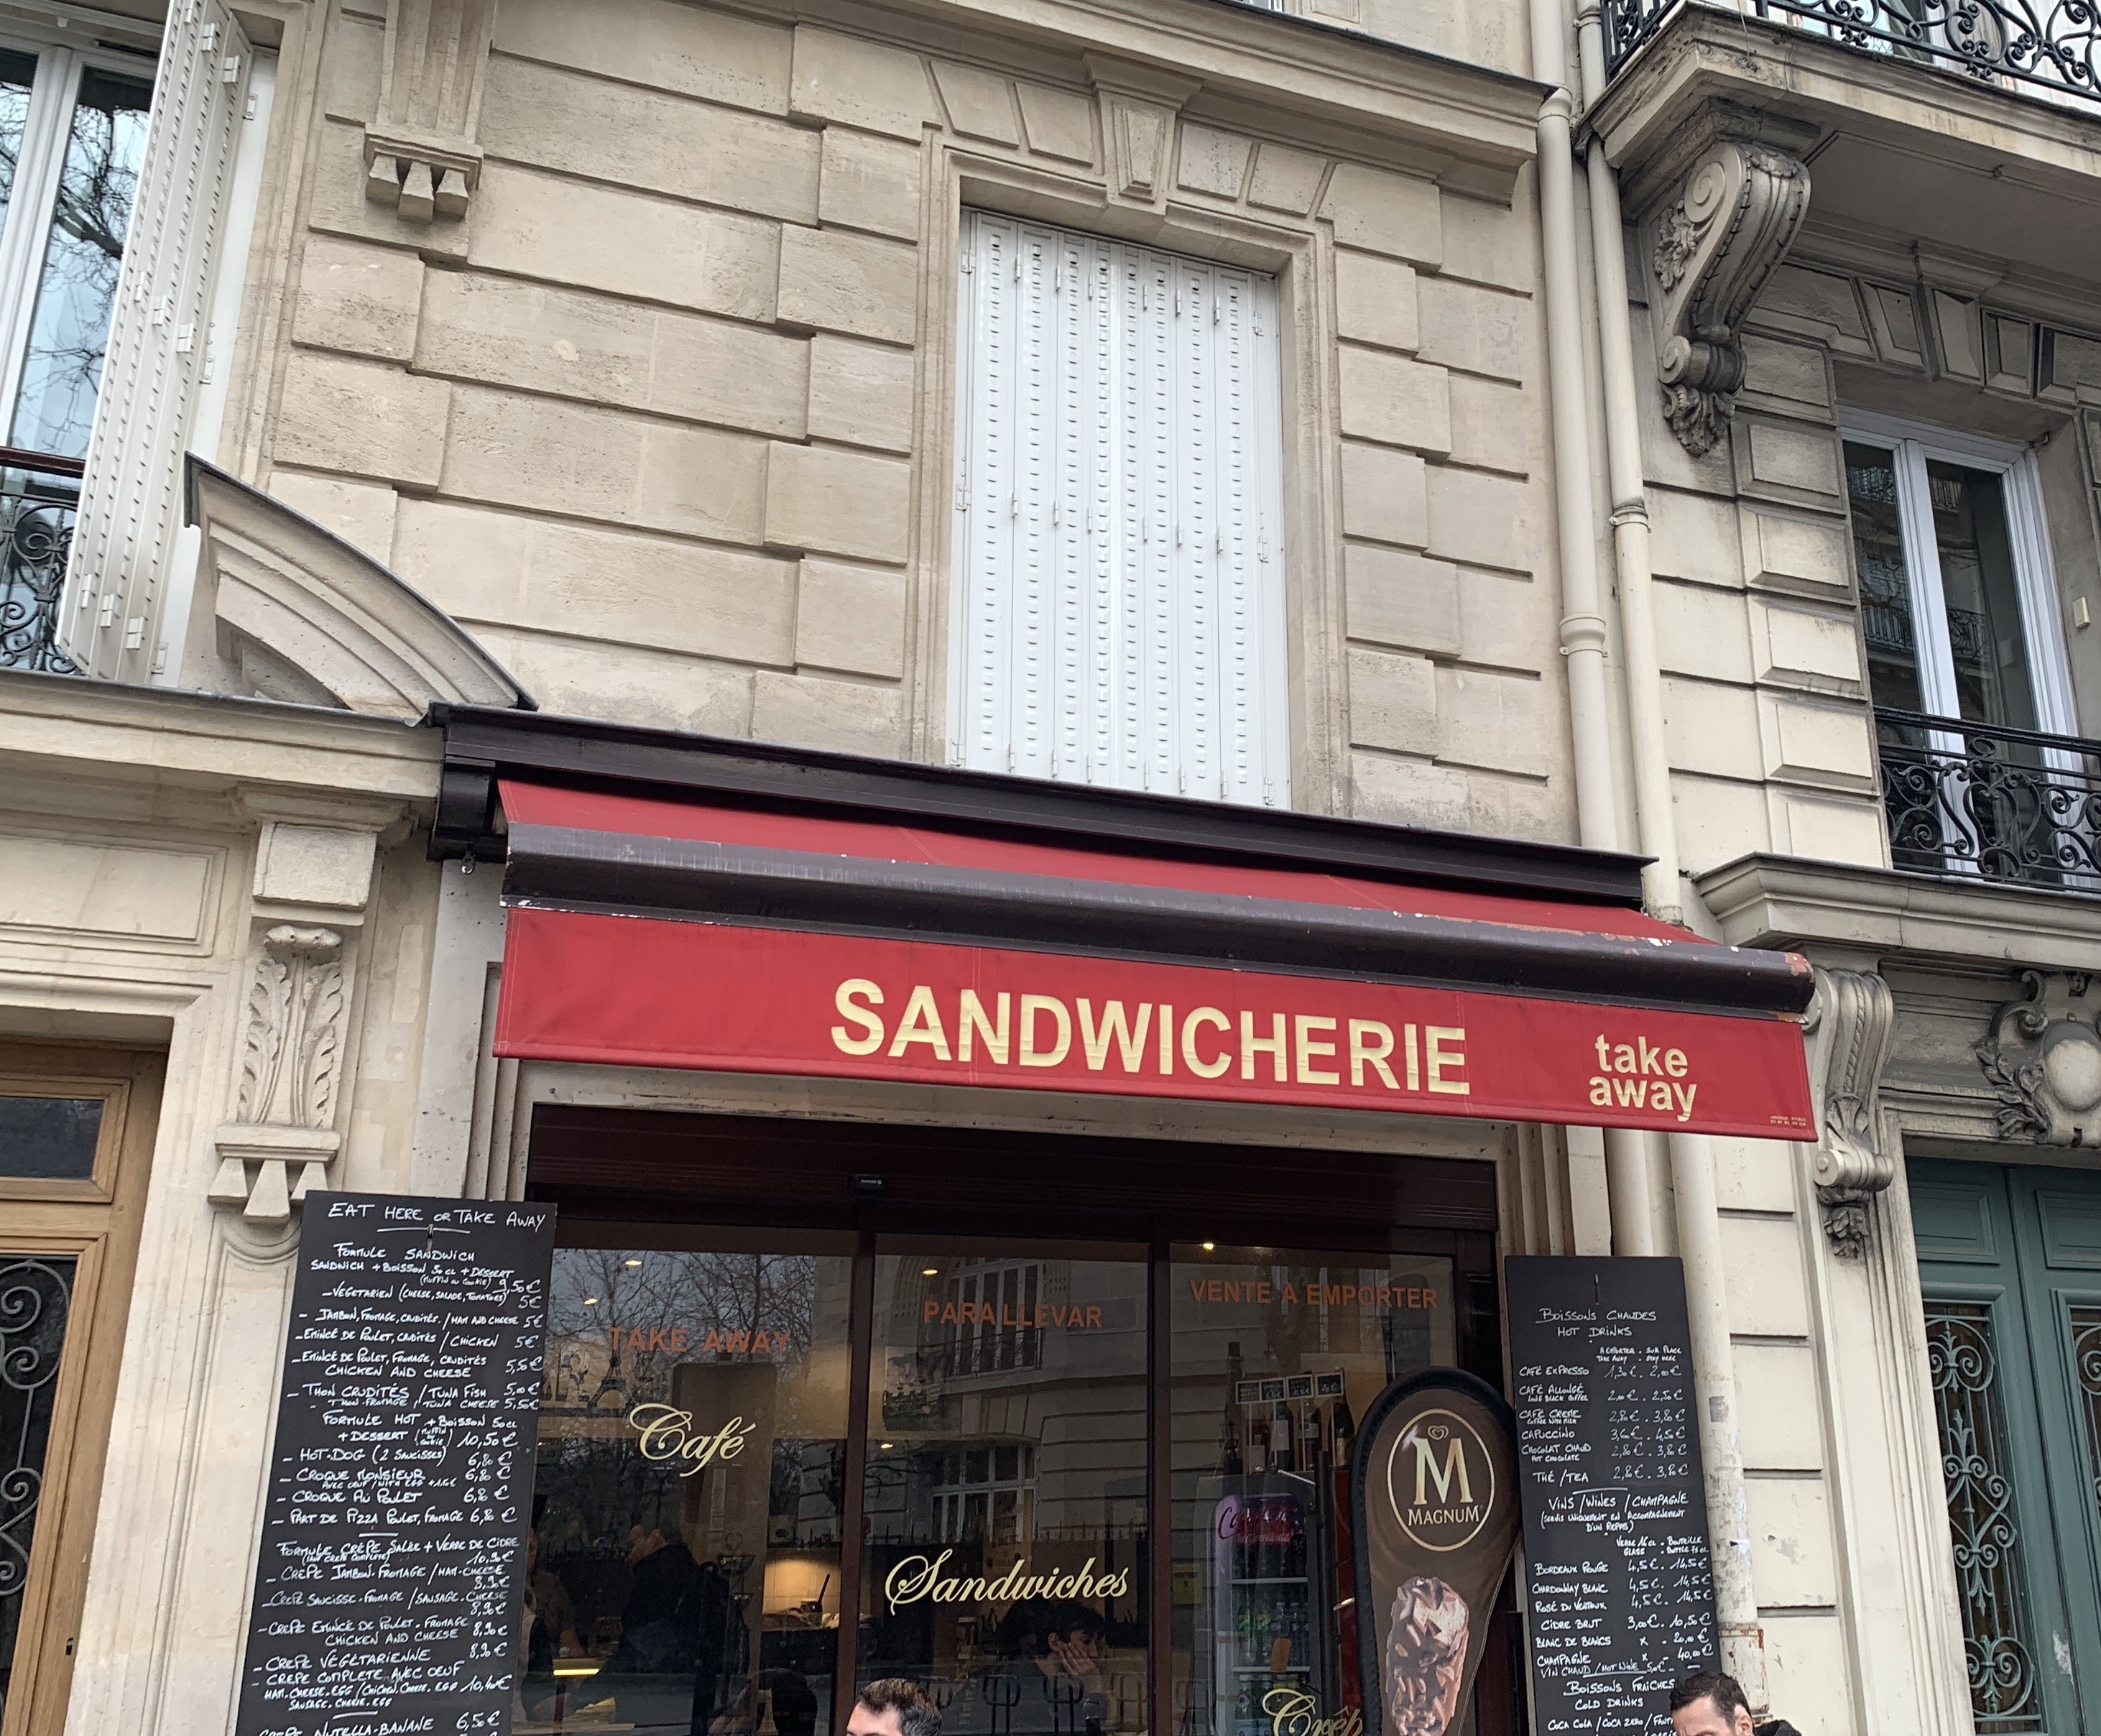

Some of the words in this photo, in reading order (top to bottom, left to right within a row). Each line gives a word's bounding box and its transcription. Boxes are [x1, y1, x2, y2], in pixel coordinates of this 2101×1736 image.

[830, 976, 1472, 1097] SANDWICHERIE
[1593, 1032, 1689, 1079] take
[1587, 1076, 1698, 1122] away
[328, 1201, 376, 1218] EAT
[384, 1206, 424, 1222] HERE
[453, 1209, 497, 1224] TAKE
[506, 1210, 546, 1233] AWAY
[310, 1259, 365, 1271] SANDWICH
[1189, 1278, 1272, 1304] VENTE
[1280, 1283, 1298, 1305] A
[1306, 1283, 1439, 1309] EMPORTER
[923, 1301, 996, 1325] PARA
[1002, 1303, 1102, 1329] LLEVAR
[1535, 1307, 1597, 1324] BOISSONS
[1606, 1309, 1657, 1321] CHAUDES
[608, 1326, 688, 1353] TAKE
[702, 1329, 791, 1354] AWAY
[1557, 1326, 1581, 1337] HOT
[1588, 1324, 1633, 1338] DRINKS
[449, 1333, 500, 1348] CHICKEN
[324, 1363, 384, 1377] CHICKEN
[389, 1365, 417, 1378] AND
[423, 1367, 471, 1378] CHEESE
[301, 1382, 336, 1398] THON
[427, 1386, 458, 1400] TUNA
[463, 1382, 486, 1399] FISH
[394, 1413, 422, 1426] HOT
[629, 1403, 757, 1477] Café
[1520, 1426, 1575, 1441] CAPUCCINO
[1521, 1444, 1561, 1455] CHOCOLAT
[1564, 1443, 1592, 1453] CHAUD
[295, 1467, 351, 1483] CROQUE
[356, 1466, 427, 1483] MONSIEUR
[1411, 1437, 1474, 1505] M
[291, 1490, 346, 1503] CROQUE
[377, 1487, 423, 1505] POULET
[1548, 1496, 1575, 1512] VINS
[290, 1508, 318, 1525] PART
[318, 1513, 338, 1525] DE
[346, 1507, 379, 1525] PIZZA
[1407, 1504, 1482, 1528] MAGNUM
[884, 1547, 1130, 1616] Sandwiches
[1541, 1618, 1571, 1631] CIDRE
[1574, 1617, 1603, 1630] BRUT
[324, 1630, 379, 1647] CHICKEN
[384, 1632, 410, 1645] AND
[413, 1628, 459, 1643] CHEESE
[1536, 1650, 1592, 1669] CHAMPAGNE
[266, 1671, 311, 1686] CREPE
[1562, 1679, 1622, 1696] BOISSONS
[1632, 1675, 1676, 1692] FRAICHES
[1574, 1699, 1601, 1711] COLD
[1606, 1694, 1644, 1708] DRINKS
